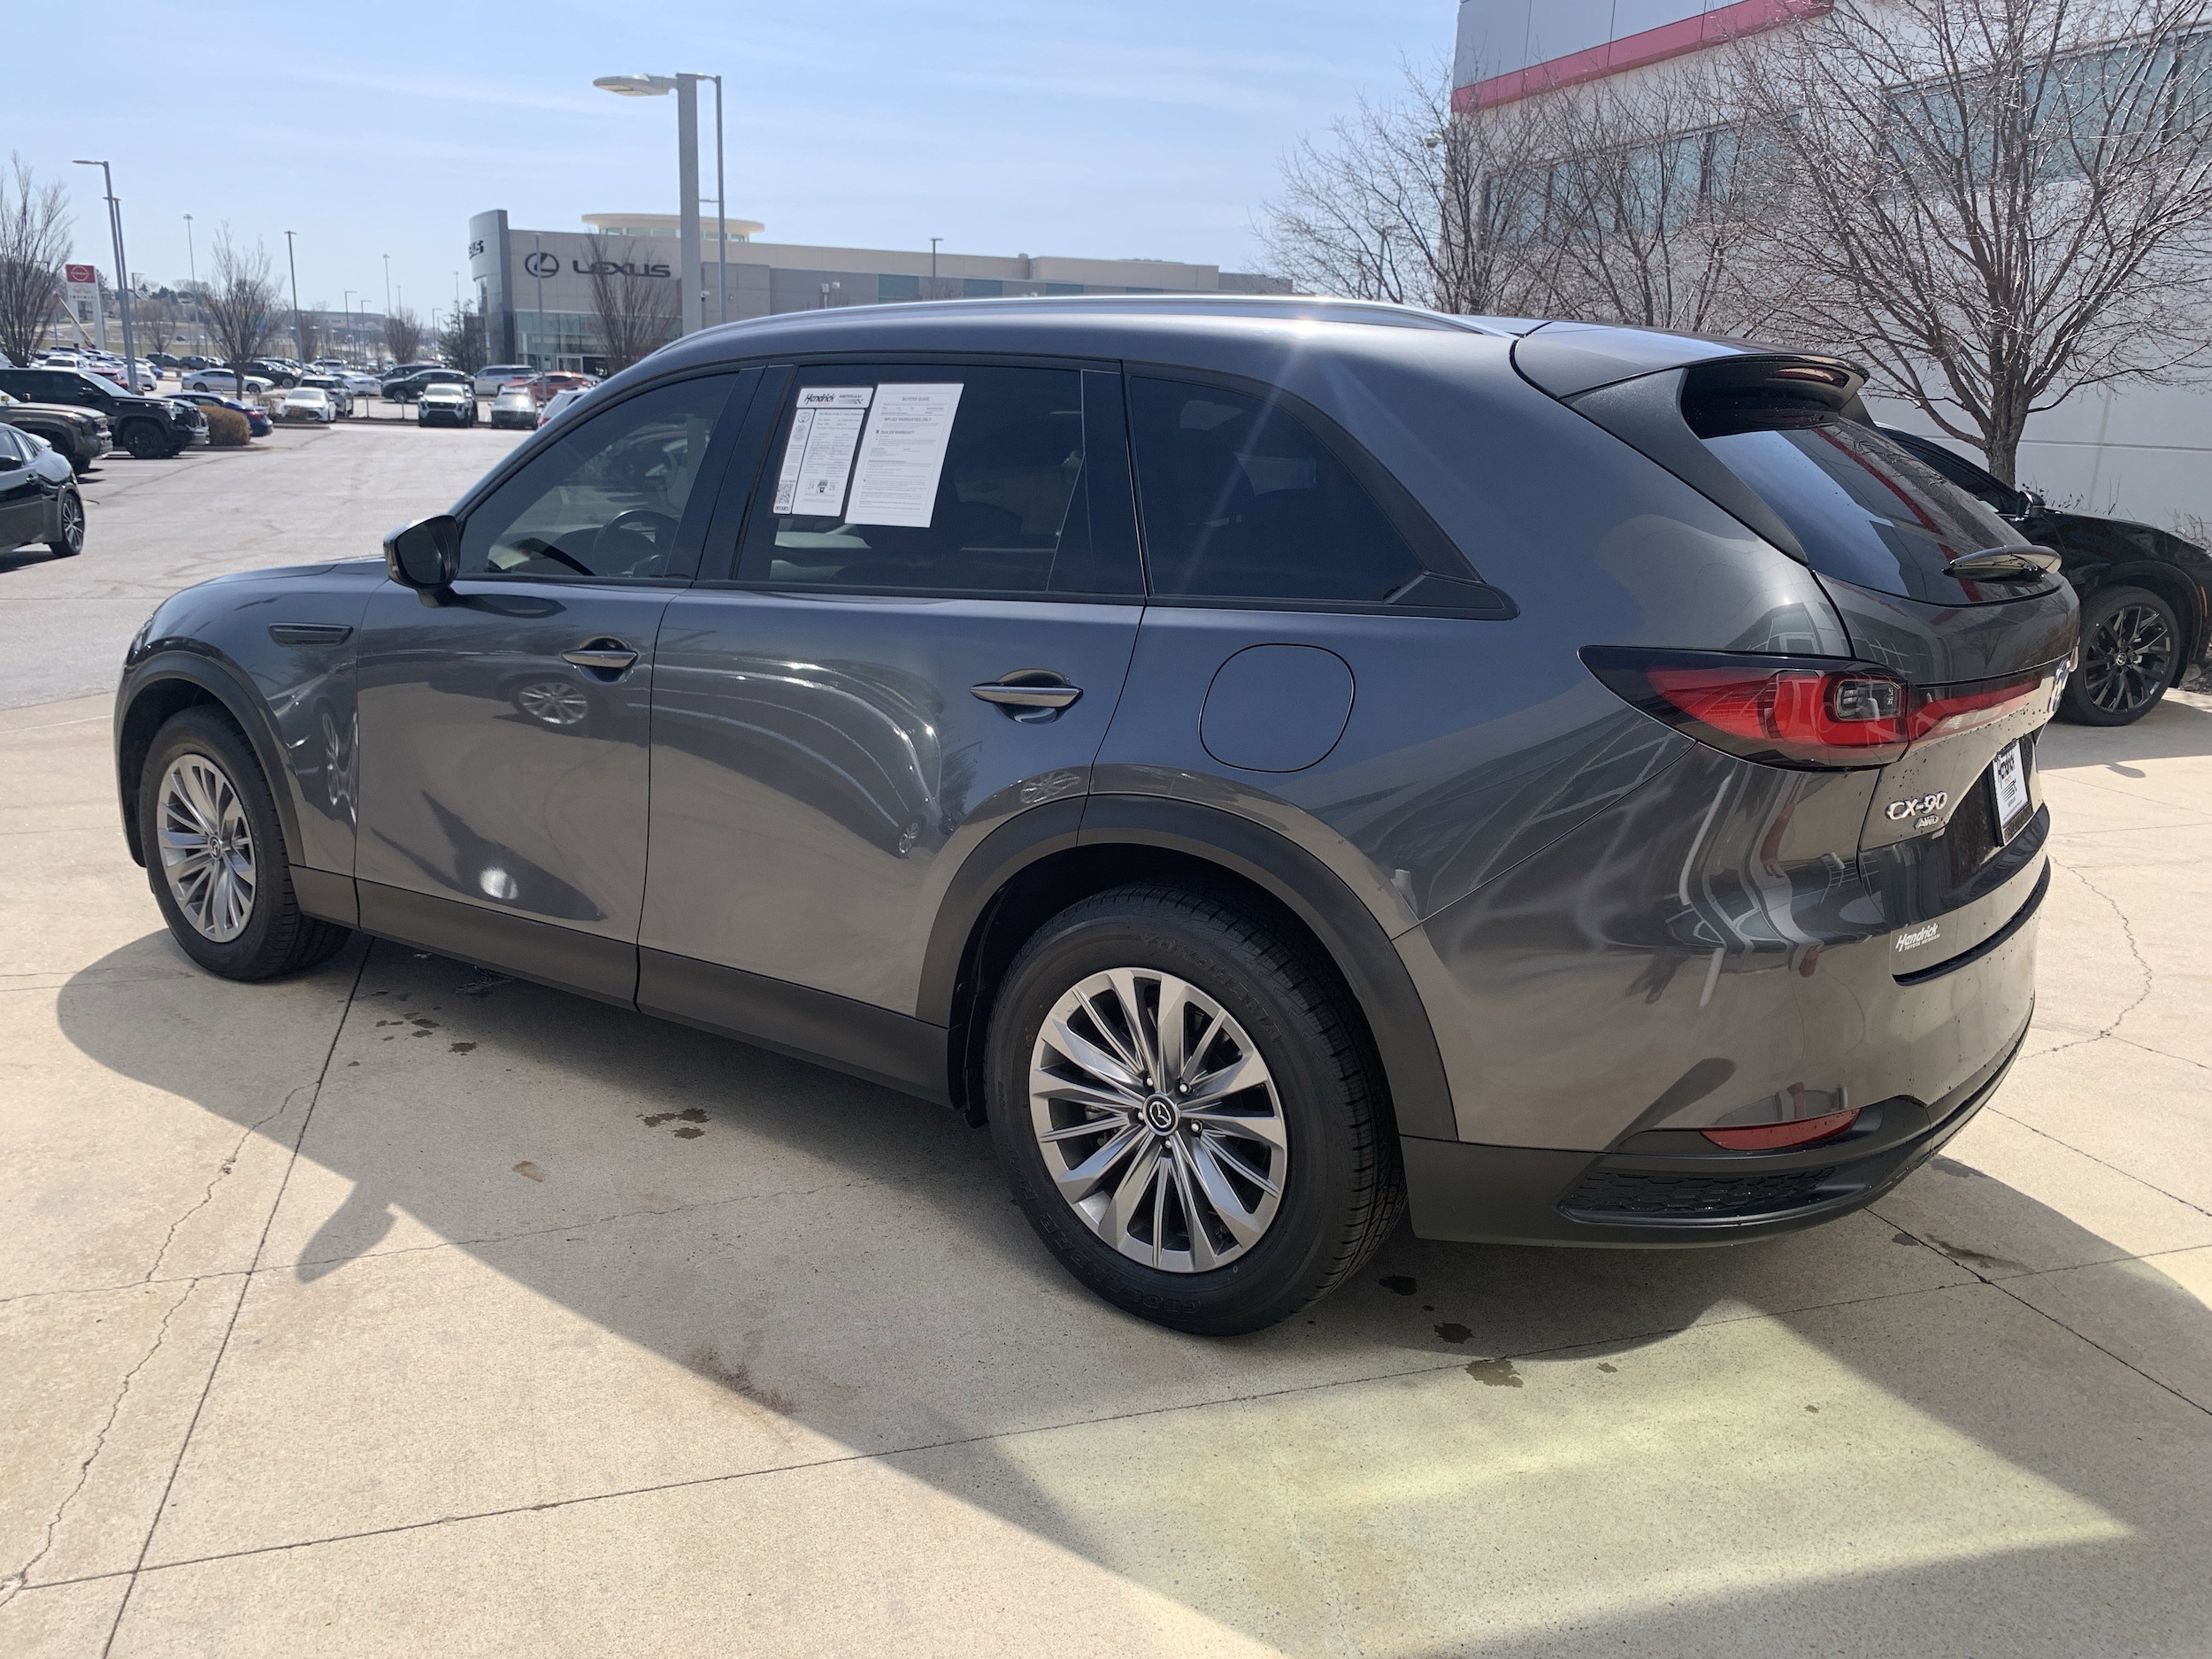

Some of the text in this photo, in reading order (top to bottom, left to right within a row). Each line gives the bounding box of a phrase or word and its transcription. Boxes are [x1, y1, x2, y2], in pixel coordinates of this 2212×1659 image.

[572, 260, 671, 278] LEXUS
[804, 394, 835, 405] Hendrick
[1886, 791, 1947, 820] CX-90
[1914, 814, 1939, 828] AWD
[1895, 923, 1939, 952] Hendrick
